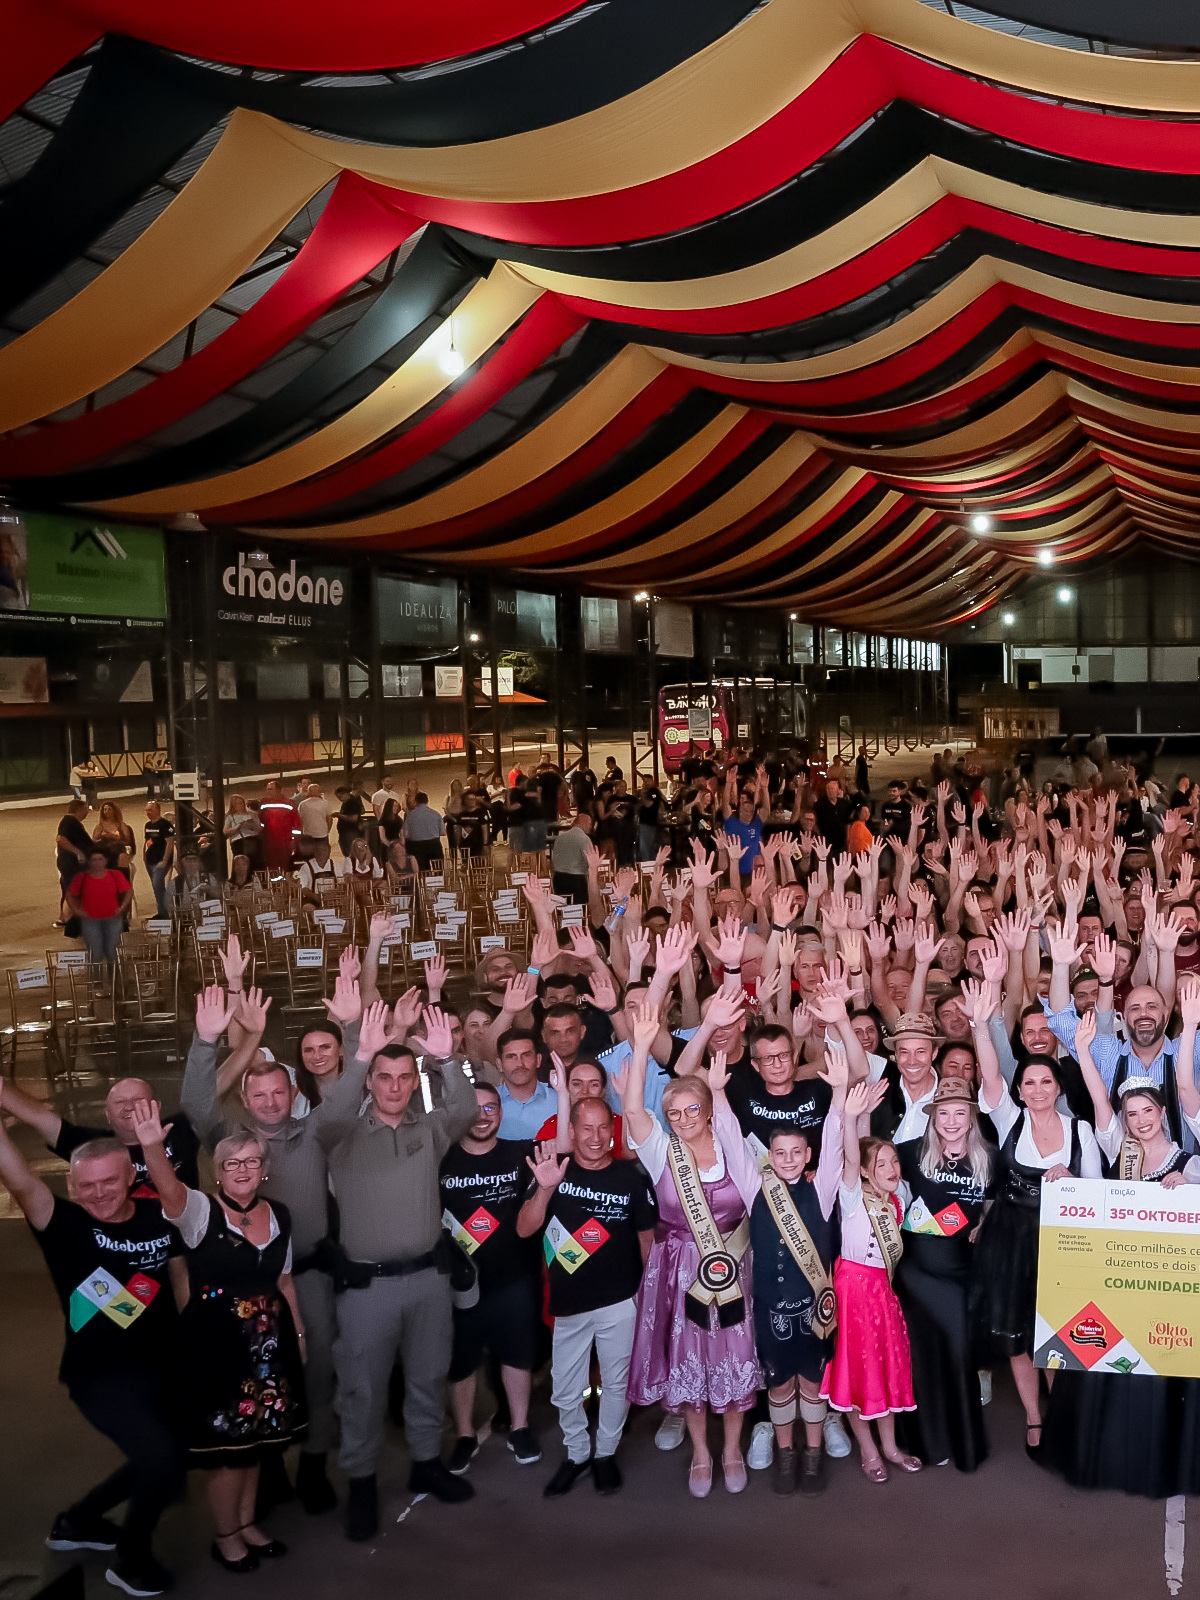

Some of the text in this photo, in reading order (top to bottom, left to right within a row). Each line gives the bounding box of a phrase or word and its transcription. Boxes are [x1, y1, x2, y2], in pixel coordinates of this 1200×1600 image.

[222, 551, 344, 606] chadane
[217, 610, 239, 620] Calvin
[240, 611, 255, 622] Klein
[289, 615, 312, 627] ELLUS
[400, 602, 453, 619] IDEALIZA
[446, 1170, 518, 1189] Oktoberfest
[558, 1181, 631, 1206] Oktoberfest
[678, 1164, 708, 1224] Oktoberfest
[1110, 1188, 1136, 1197] EDIÇÃO
[1059, 1205, 1096, 1218] 2024
[1110, 1207, 1134, 1220] 35ª
[94, 1233, 172, 1255] Oktoberfest
[781, 1214, 811, 1259] Oktoberfest
[1106, 1240, 1138, 1252] Cinco
[1141, 1243, 1187, 1255] milhões
[1105, 1257, 1159, 1269] duzentos
[1162, 1262, 1169, 1270] e
[1172, 1261, 1196, 1272] dois
[1104, 1277, 1200, 1294] COMUNIDADE
[1155, 1322, 1188, 1338] Okto
[1148, 1331, 1194, 1350] berfest
